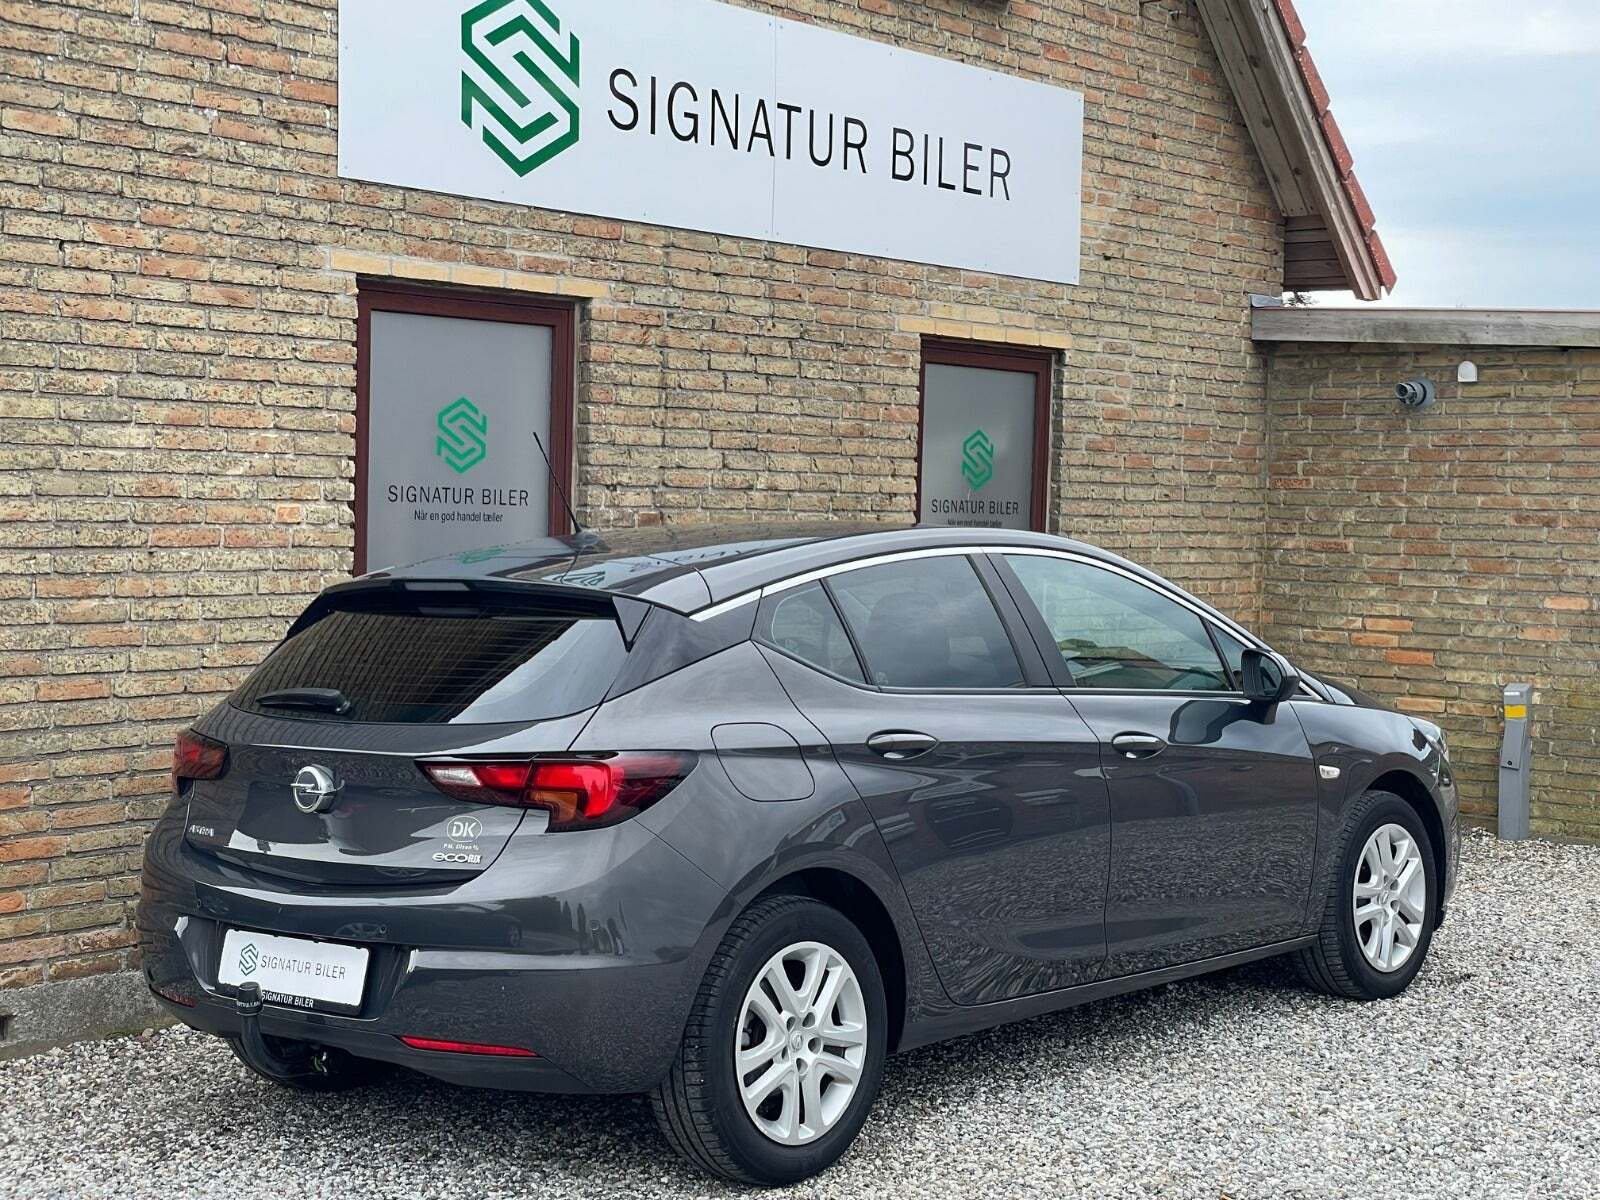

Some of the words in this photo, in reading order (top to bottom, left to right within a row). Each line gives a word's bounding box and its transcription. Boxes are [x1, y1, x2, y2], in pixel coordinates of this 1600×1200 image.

[607, 68, 868, 174] SIGNATUR
[891, 127, 1011, 201] BILER
[387, 484, 475, 505] SIGNATUR
[482, 488, 529, 507] BILER
[931, 498, 985, 515] SIGNATUR
[989, 500, 1020, 516] BILER
[429, 511, 440, 521] en
[441, 510, 456, 524] god
[456, 511, 482, 522] handel
[451, 821, 477, 838] DK
[260, 955, 312, 975] SIGNATUR
[315, 962, 346, 980] BILER
[261, 990, 294, 1006] SIGNATUR
[294, 994, 315, 1009] BILER
